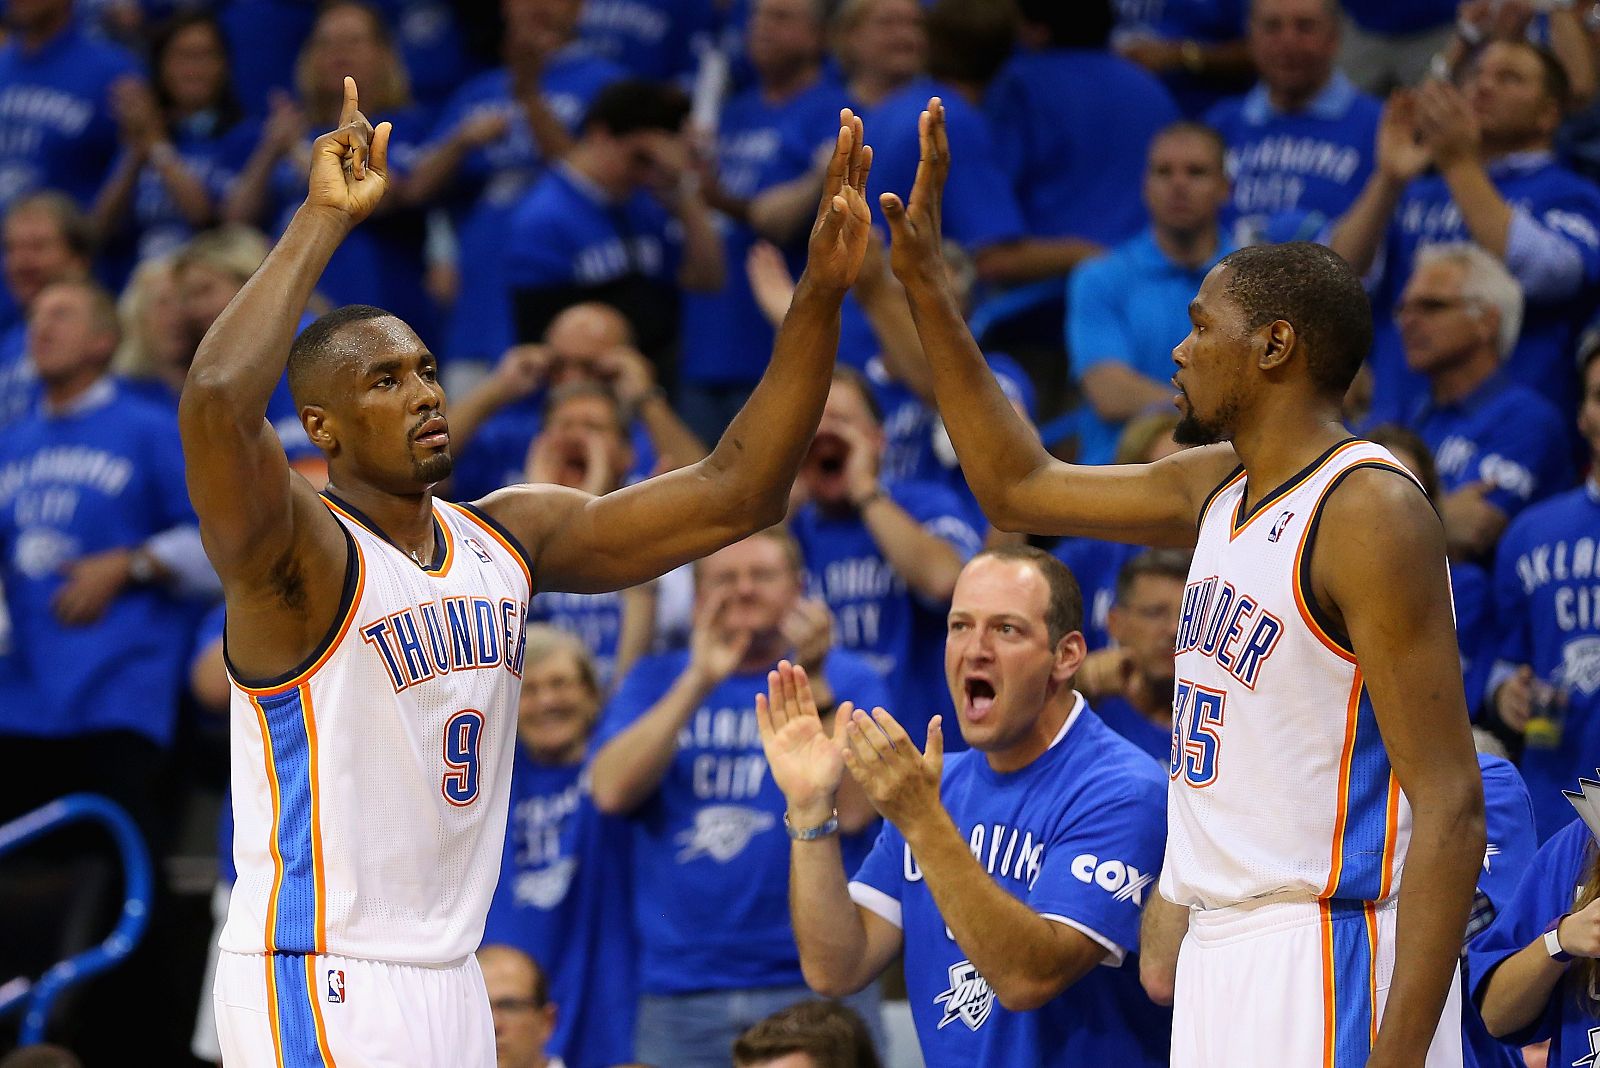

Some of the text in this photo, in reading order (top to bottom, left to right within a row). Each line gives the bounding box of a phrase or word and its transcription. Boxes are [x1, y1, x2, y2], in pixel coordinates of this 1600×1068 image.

[442, 708, 486, 807] 9
[1171, 678, 1228, 789] 35
[1071, 853, 1155, 907] COX
